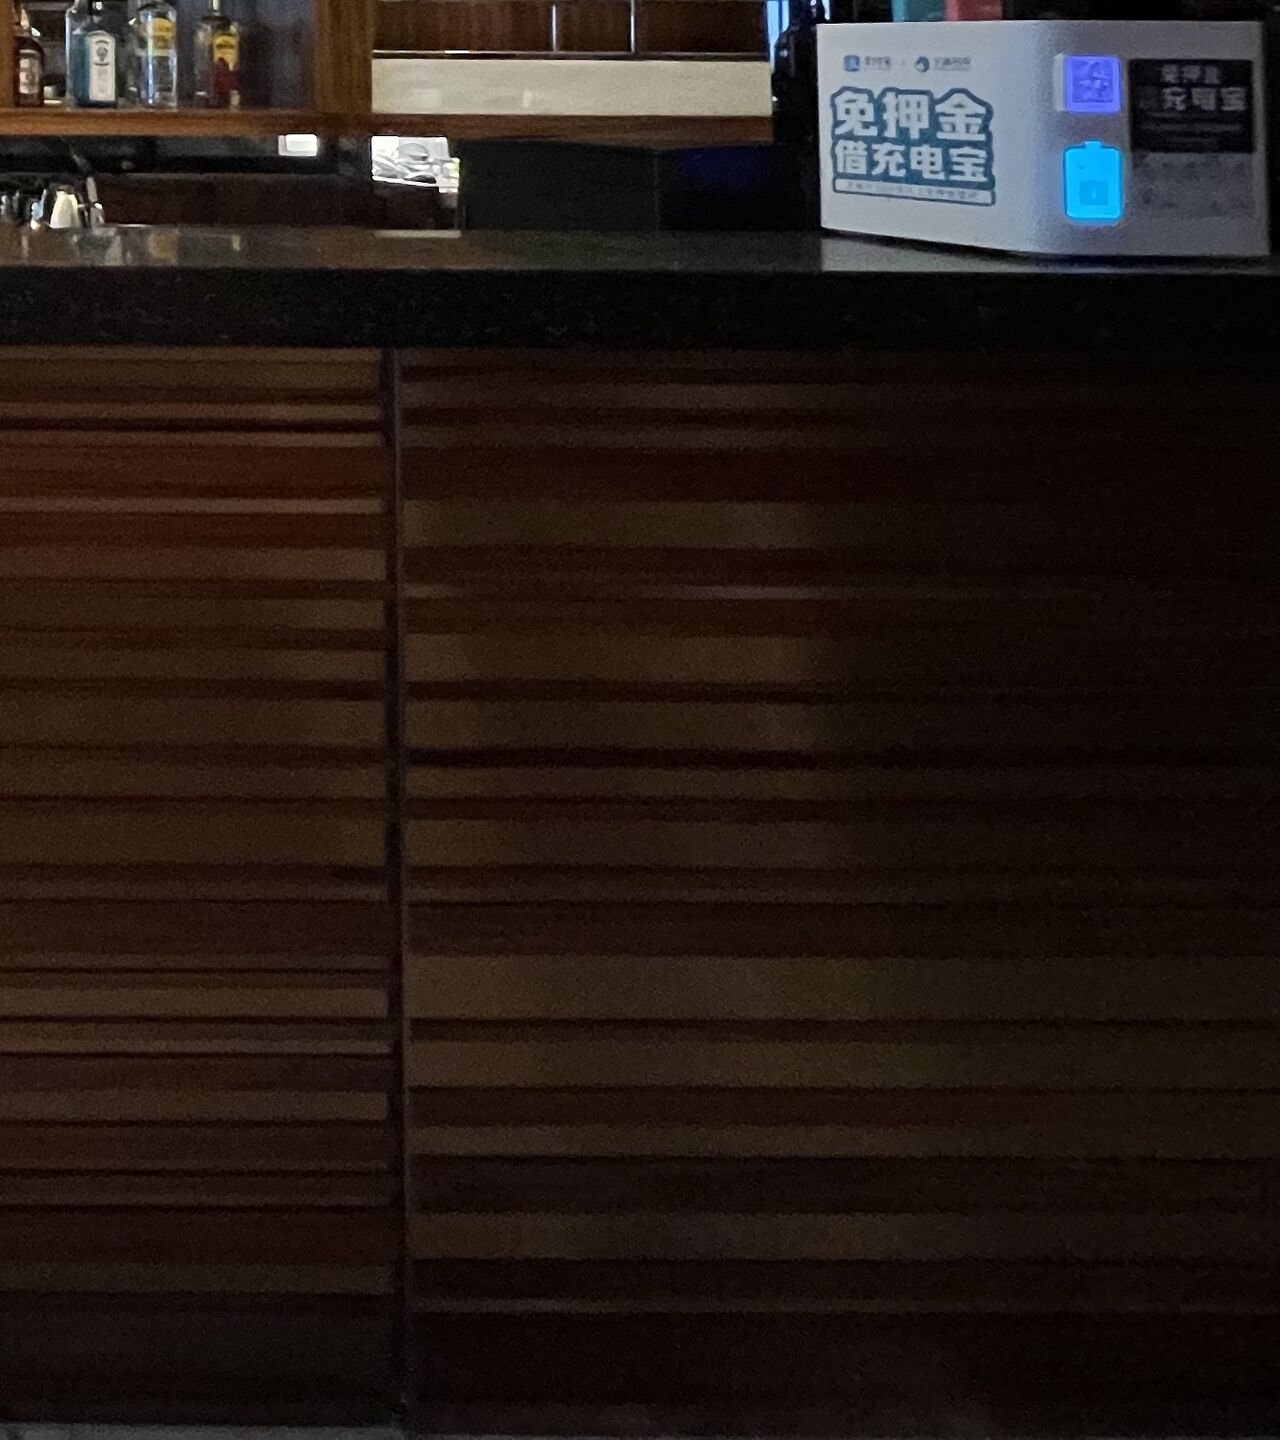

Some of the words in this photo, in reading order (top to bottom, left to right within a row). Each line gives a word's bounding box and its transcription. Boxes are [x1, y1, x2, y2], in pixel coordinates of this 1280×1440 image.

[834, 90, 987, 141] 免押金
[834, 139, 990, 183] 借充电宝
